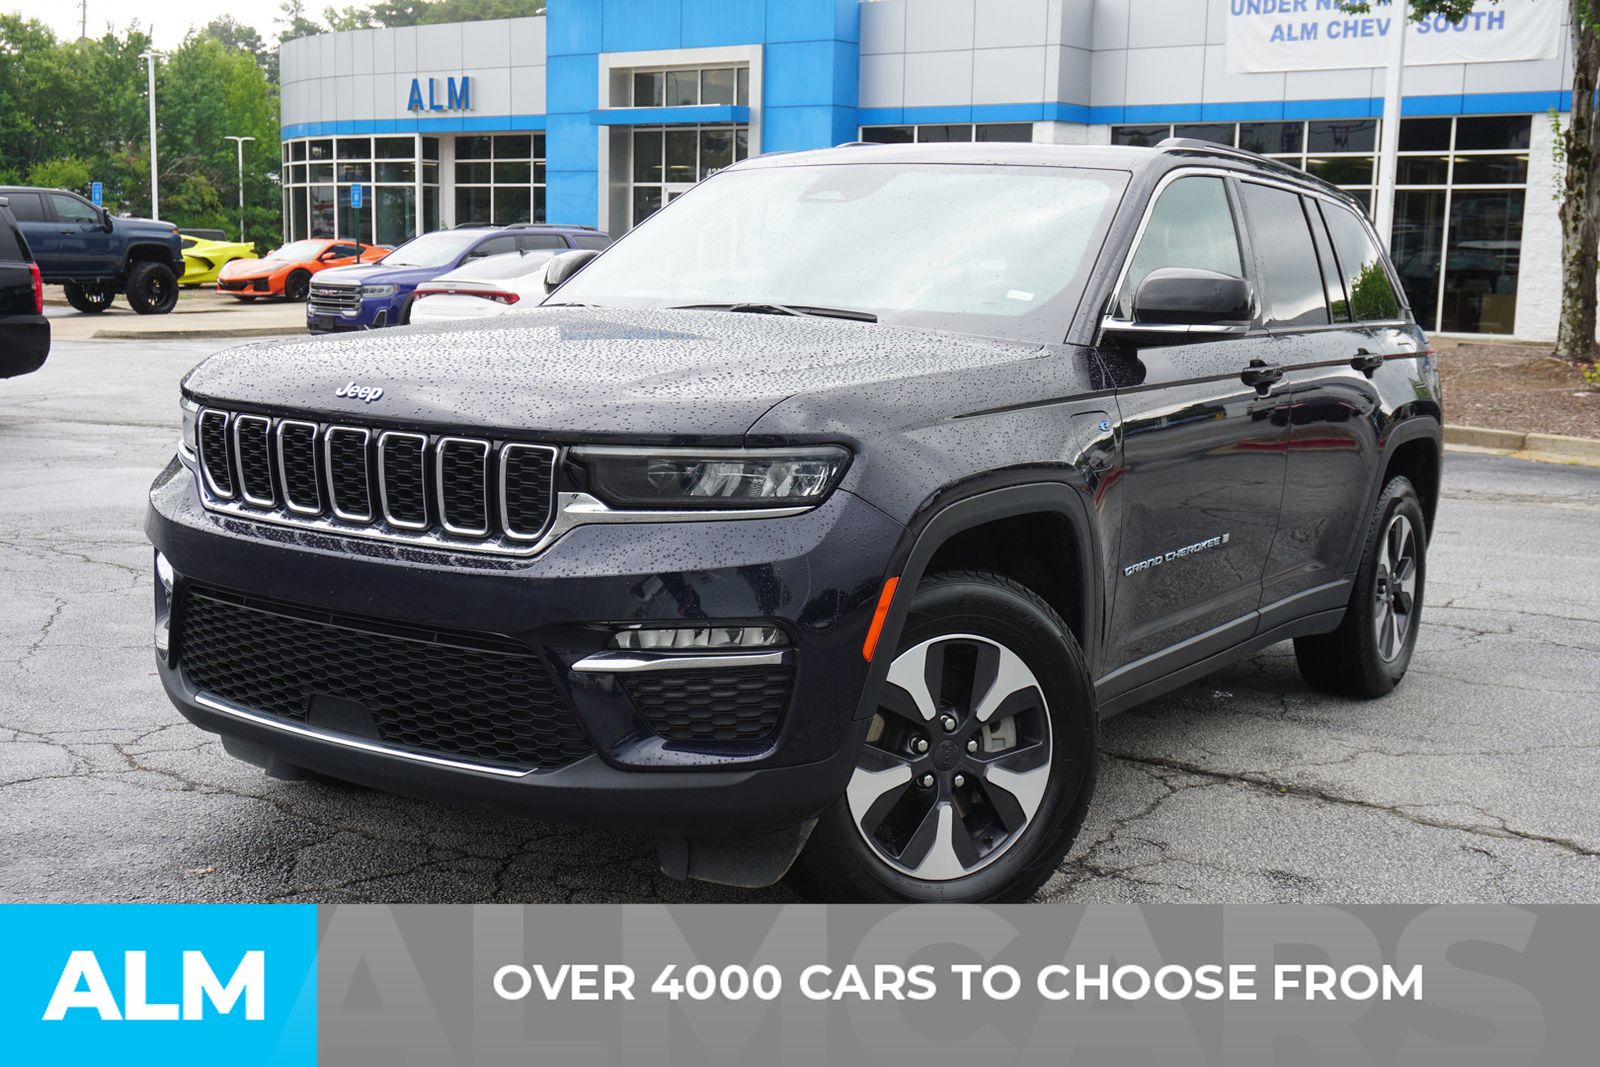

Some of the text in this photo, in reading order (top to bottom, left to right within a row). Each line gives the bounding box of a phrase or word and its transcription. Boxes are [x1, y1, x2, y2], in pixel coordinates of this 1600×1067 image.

[1231, 0, 1307, 16] UNDER
[1270, 22, 1318, 42] ALM
[1326, 18, 1391, 40] CHEV
[407, 76, 470, 111] ALM
[335, 381, 384, 403] Jeep
[1123, 536, 1221, 576] GRAND CHEROKEE
